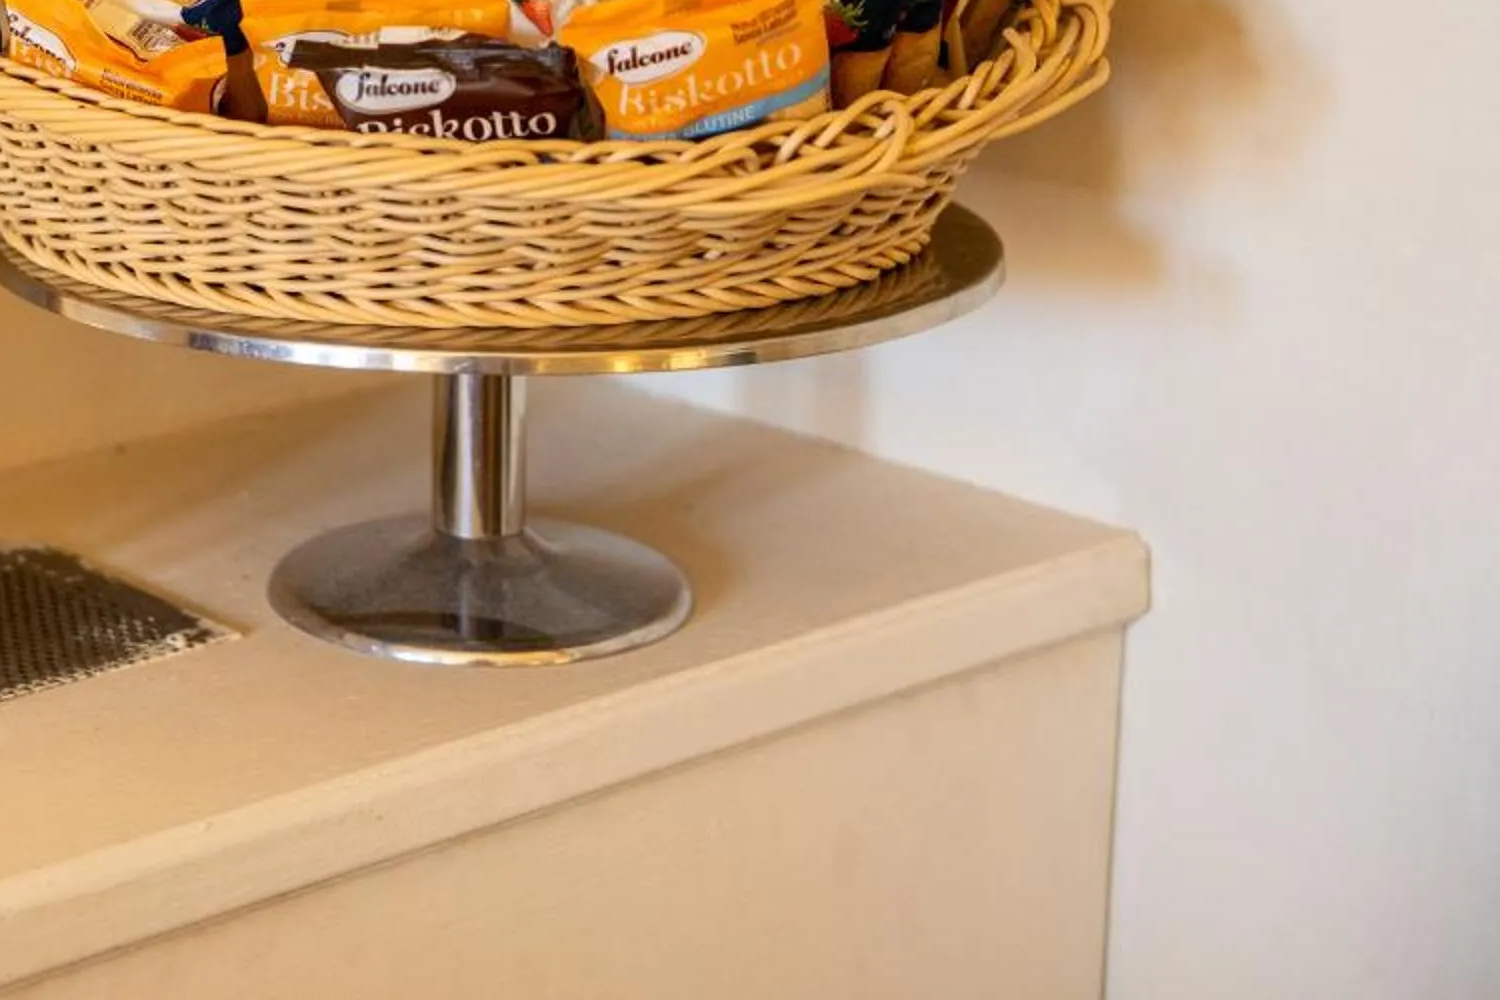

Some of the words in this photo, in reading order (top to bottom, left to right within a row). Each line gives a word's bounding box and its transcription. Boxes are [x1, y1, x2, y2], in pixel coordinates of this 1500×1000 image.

[606, 40, 693, 75] falcone
[355, 72, 440, 100] falcone
[620, 43, 801, 116] Biskotto
